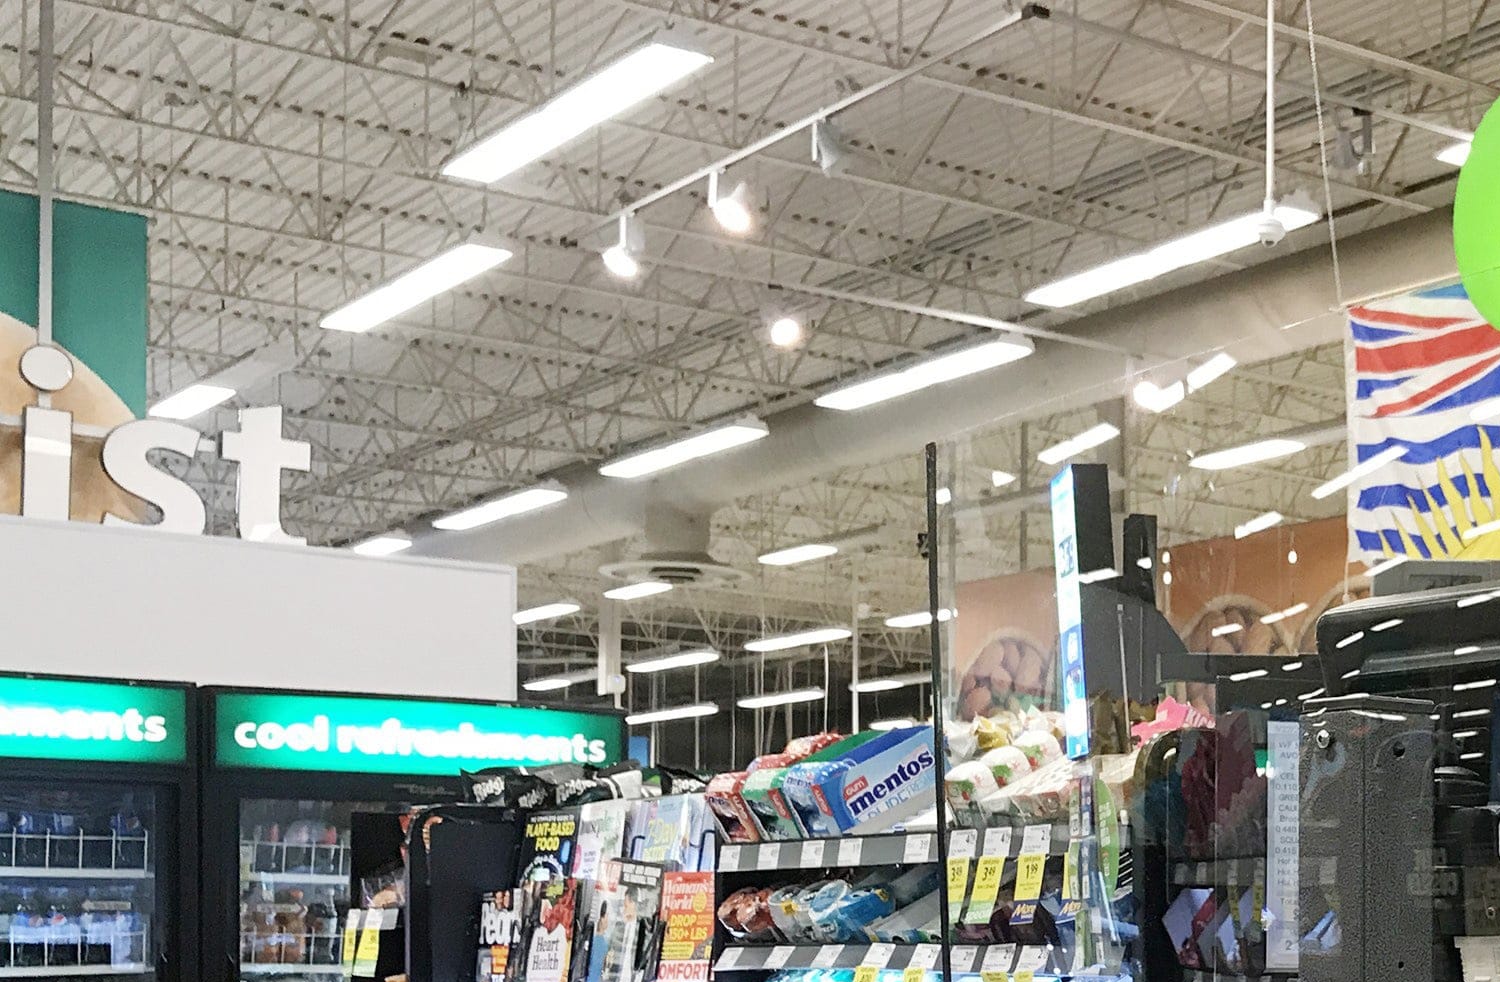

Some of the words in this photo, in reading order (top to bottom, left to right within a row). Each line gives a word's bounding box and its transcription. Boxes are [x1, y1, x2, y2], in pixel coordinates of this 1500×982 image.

[0, 704, 167, 742] ments
[234, 715, 329, 753] cool
[337, 717, 606, 763] refreshments
[849, 750, 934, 817] mentos
[525, 820, 576, 838] PLANT-BASED
[535, 837, 560, 852] FOOD
[670, 914, 697, 927] DROP
[690, 927, 708, 940] LBS
[536, 937, 560, 952] Heart
[532, 953, 559, 971] Health
